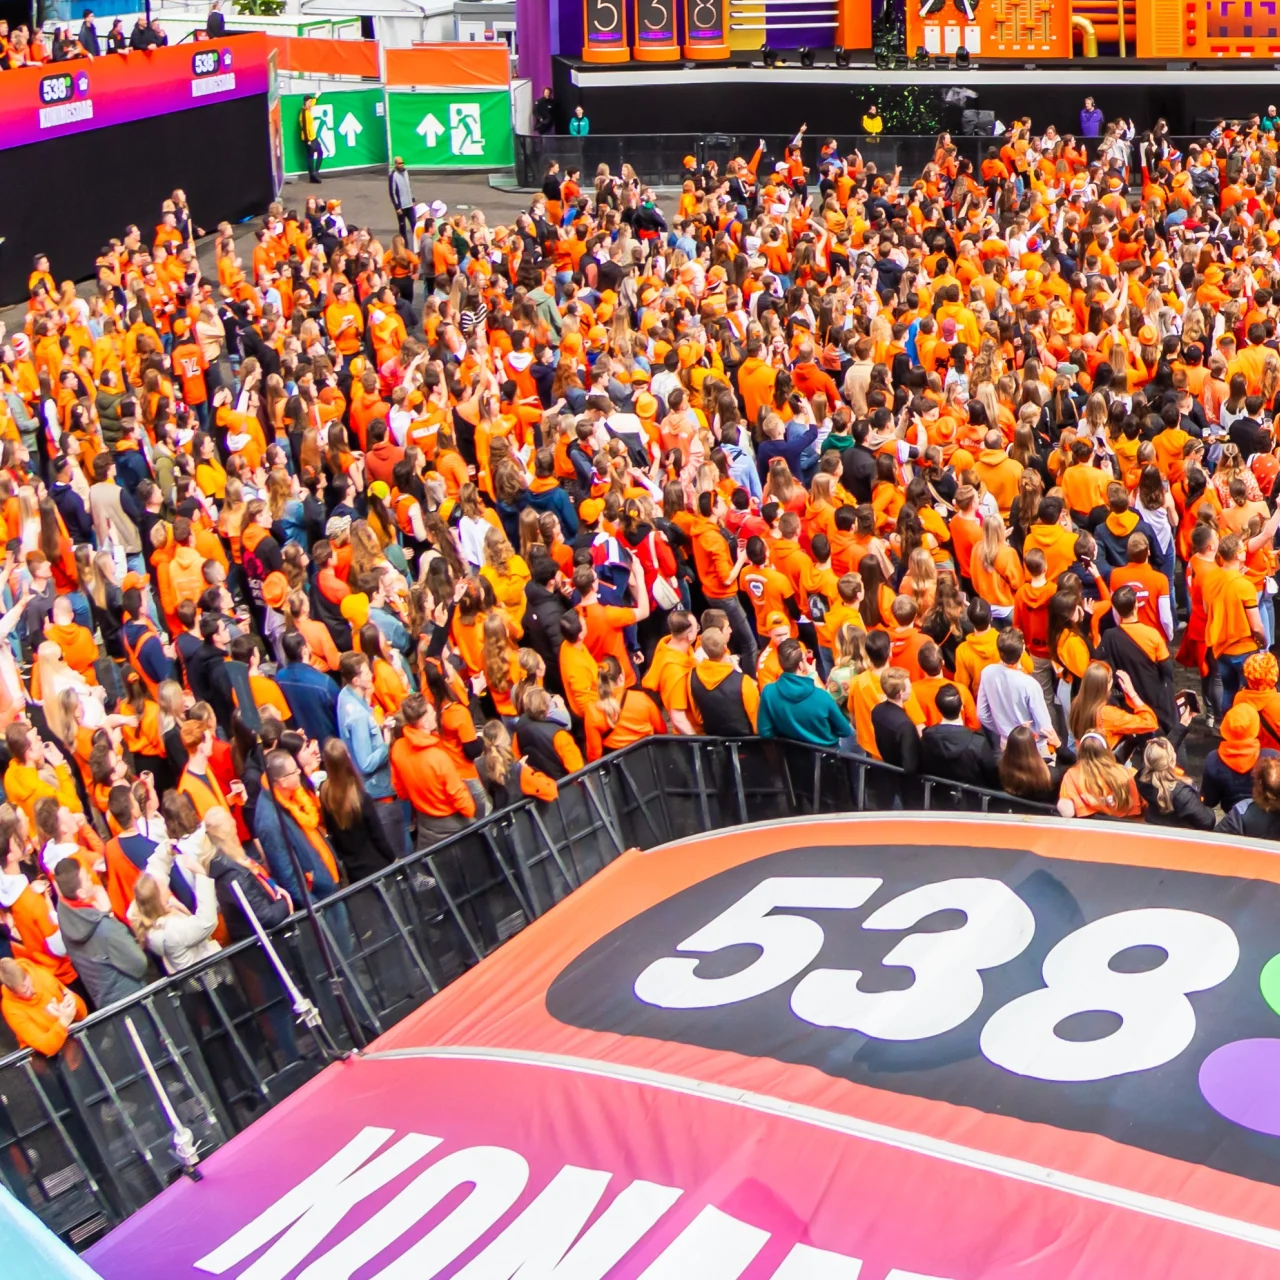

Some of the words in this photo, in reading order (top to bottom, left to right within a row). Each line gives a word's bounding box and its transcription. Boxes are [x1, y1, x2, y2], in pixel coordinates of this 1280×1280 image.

[43, 77, 66, 101] 538
[192, 53, 215, 74] 538
[633, 876, 1241, 1082] 538
[192, 1125, 957, 1280] KON
